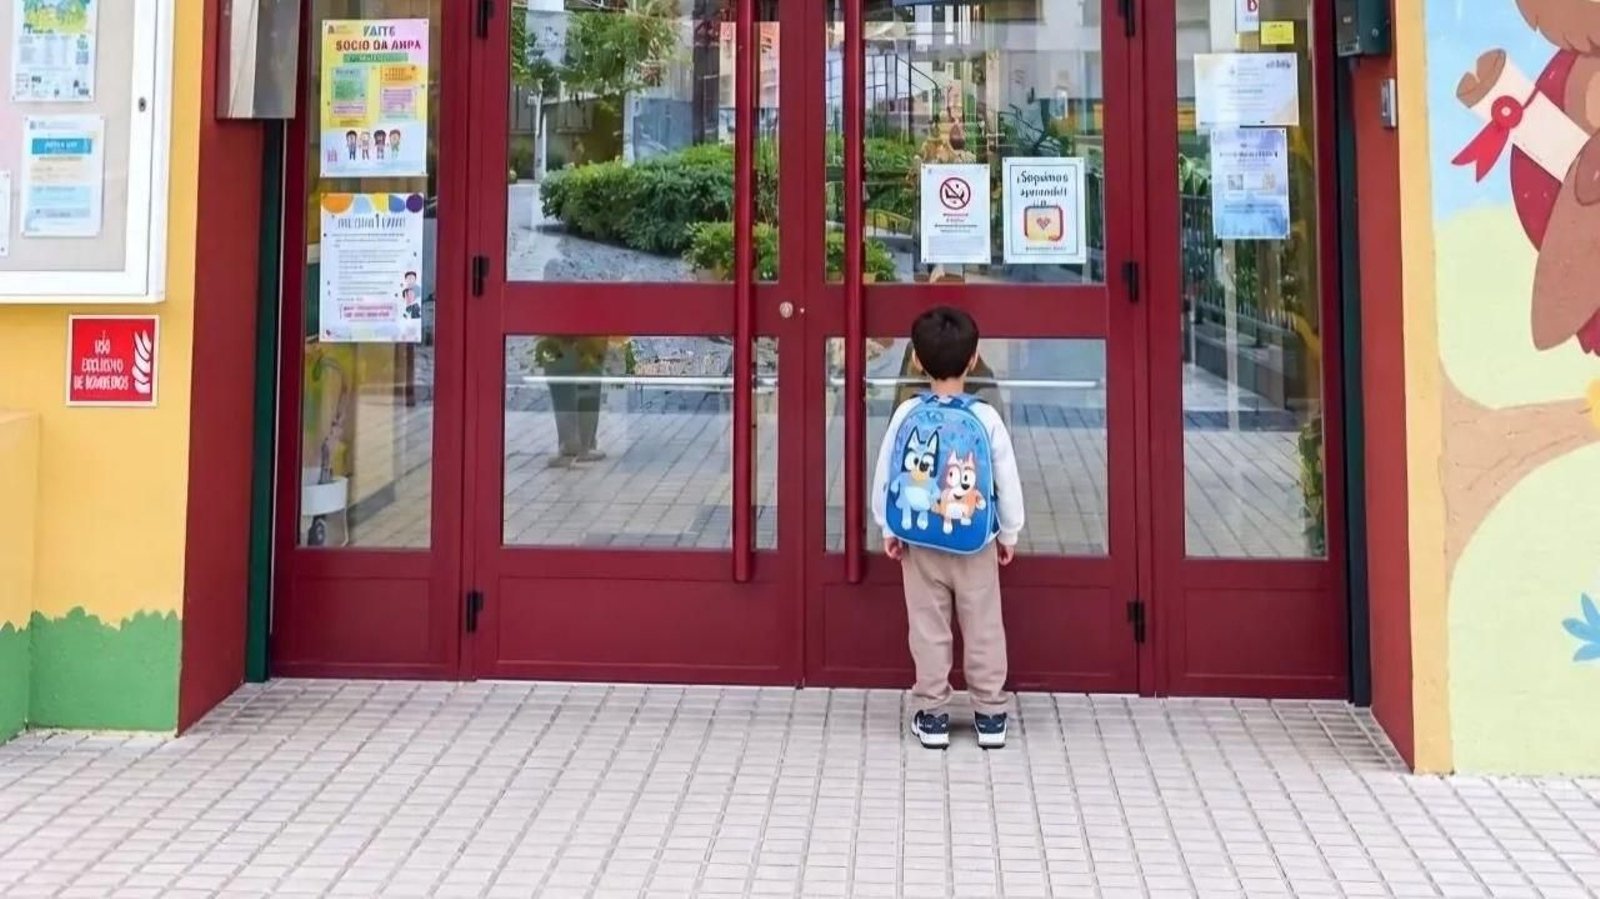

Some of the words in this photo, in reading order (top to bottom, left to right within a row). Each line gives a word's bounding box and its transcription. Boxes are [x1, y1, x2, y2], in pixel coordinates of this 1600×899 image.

[336, 39, 370, 51] SOCIO
[373, 39, 388, 51] DA
[73, 375, 84, 390] DE
